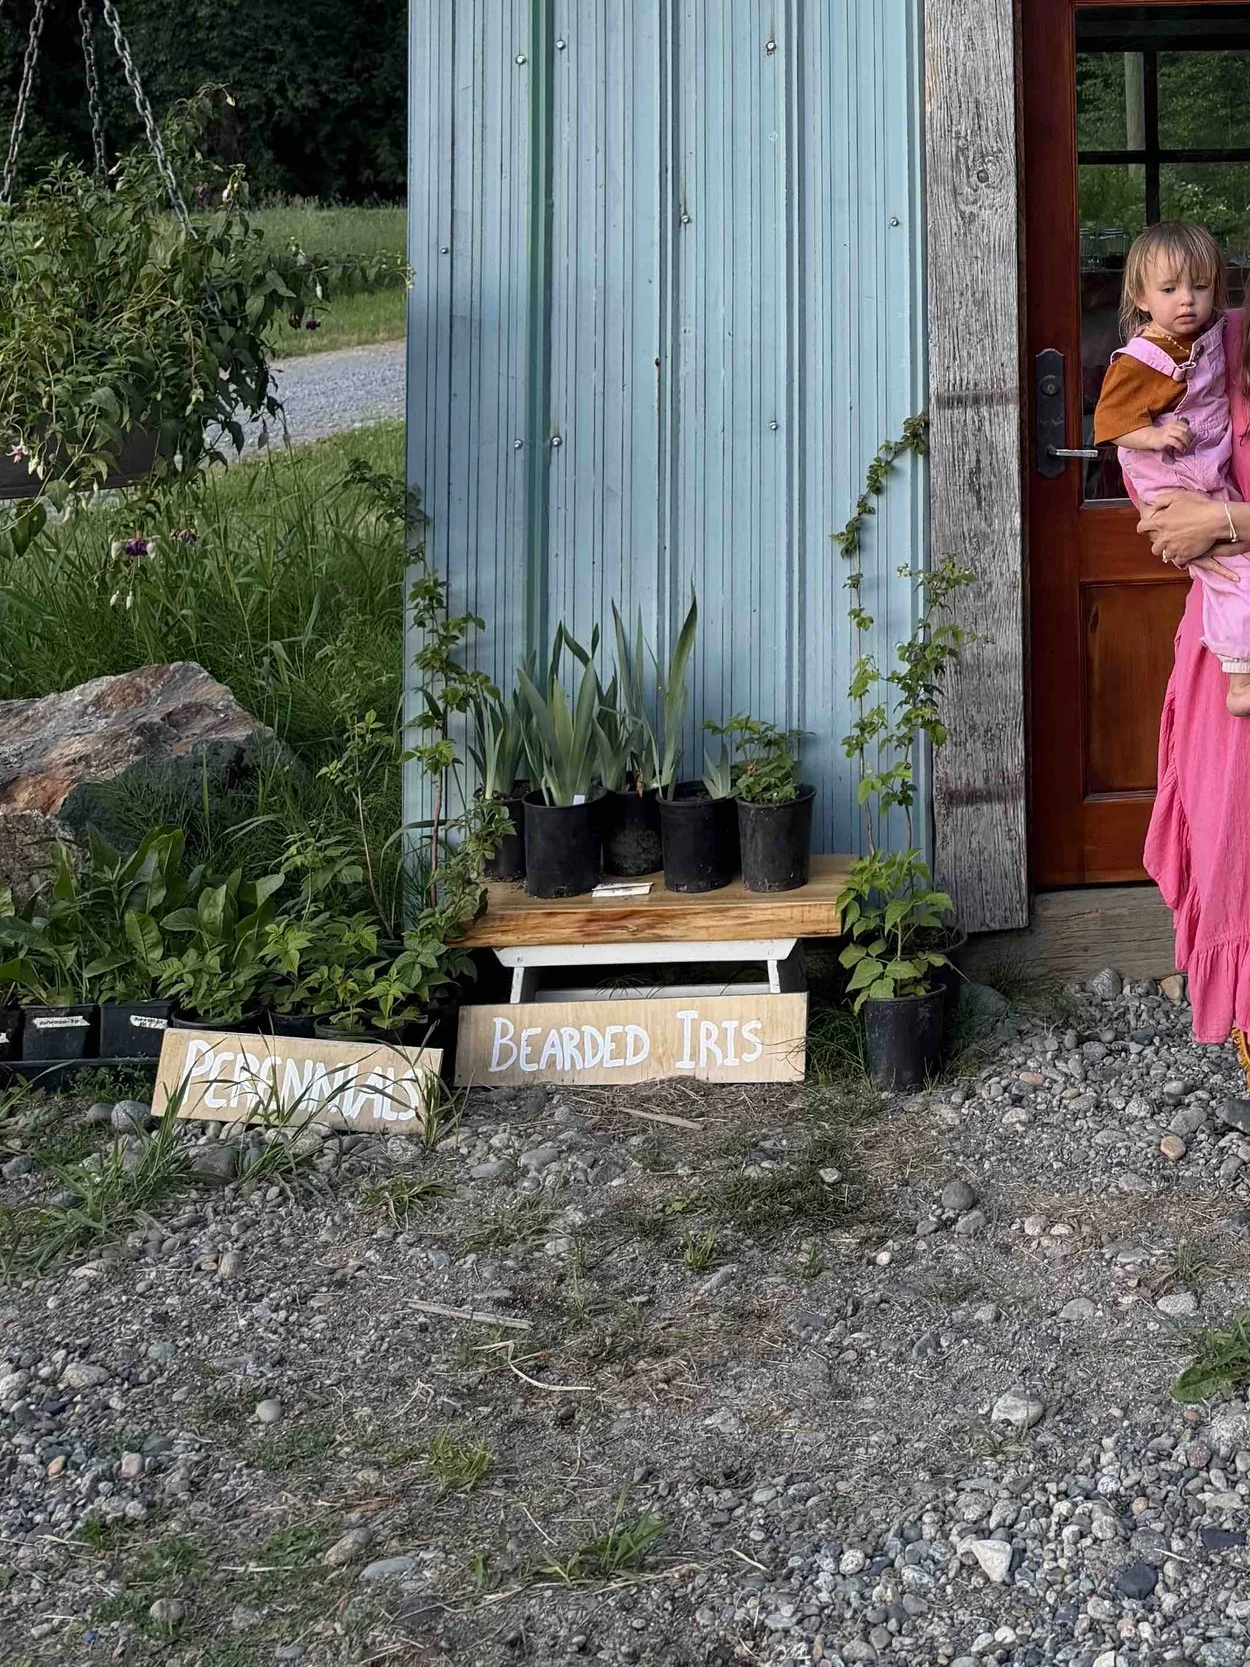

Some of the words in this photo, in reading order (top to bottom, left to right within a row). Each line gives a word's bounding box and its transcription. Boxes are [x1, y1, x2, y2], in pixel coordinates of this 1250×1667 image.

[488, 1017, 650, 1073] BEARDED
[675, 1010, 764, 1069] IRIS
[180, 1039, 424, 1121] PERENNIALS
